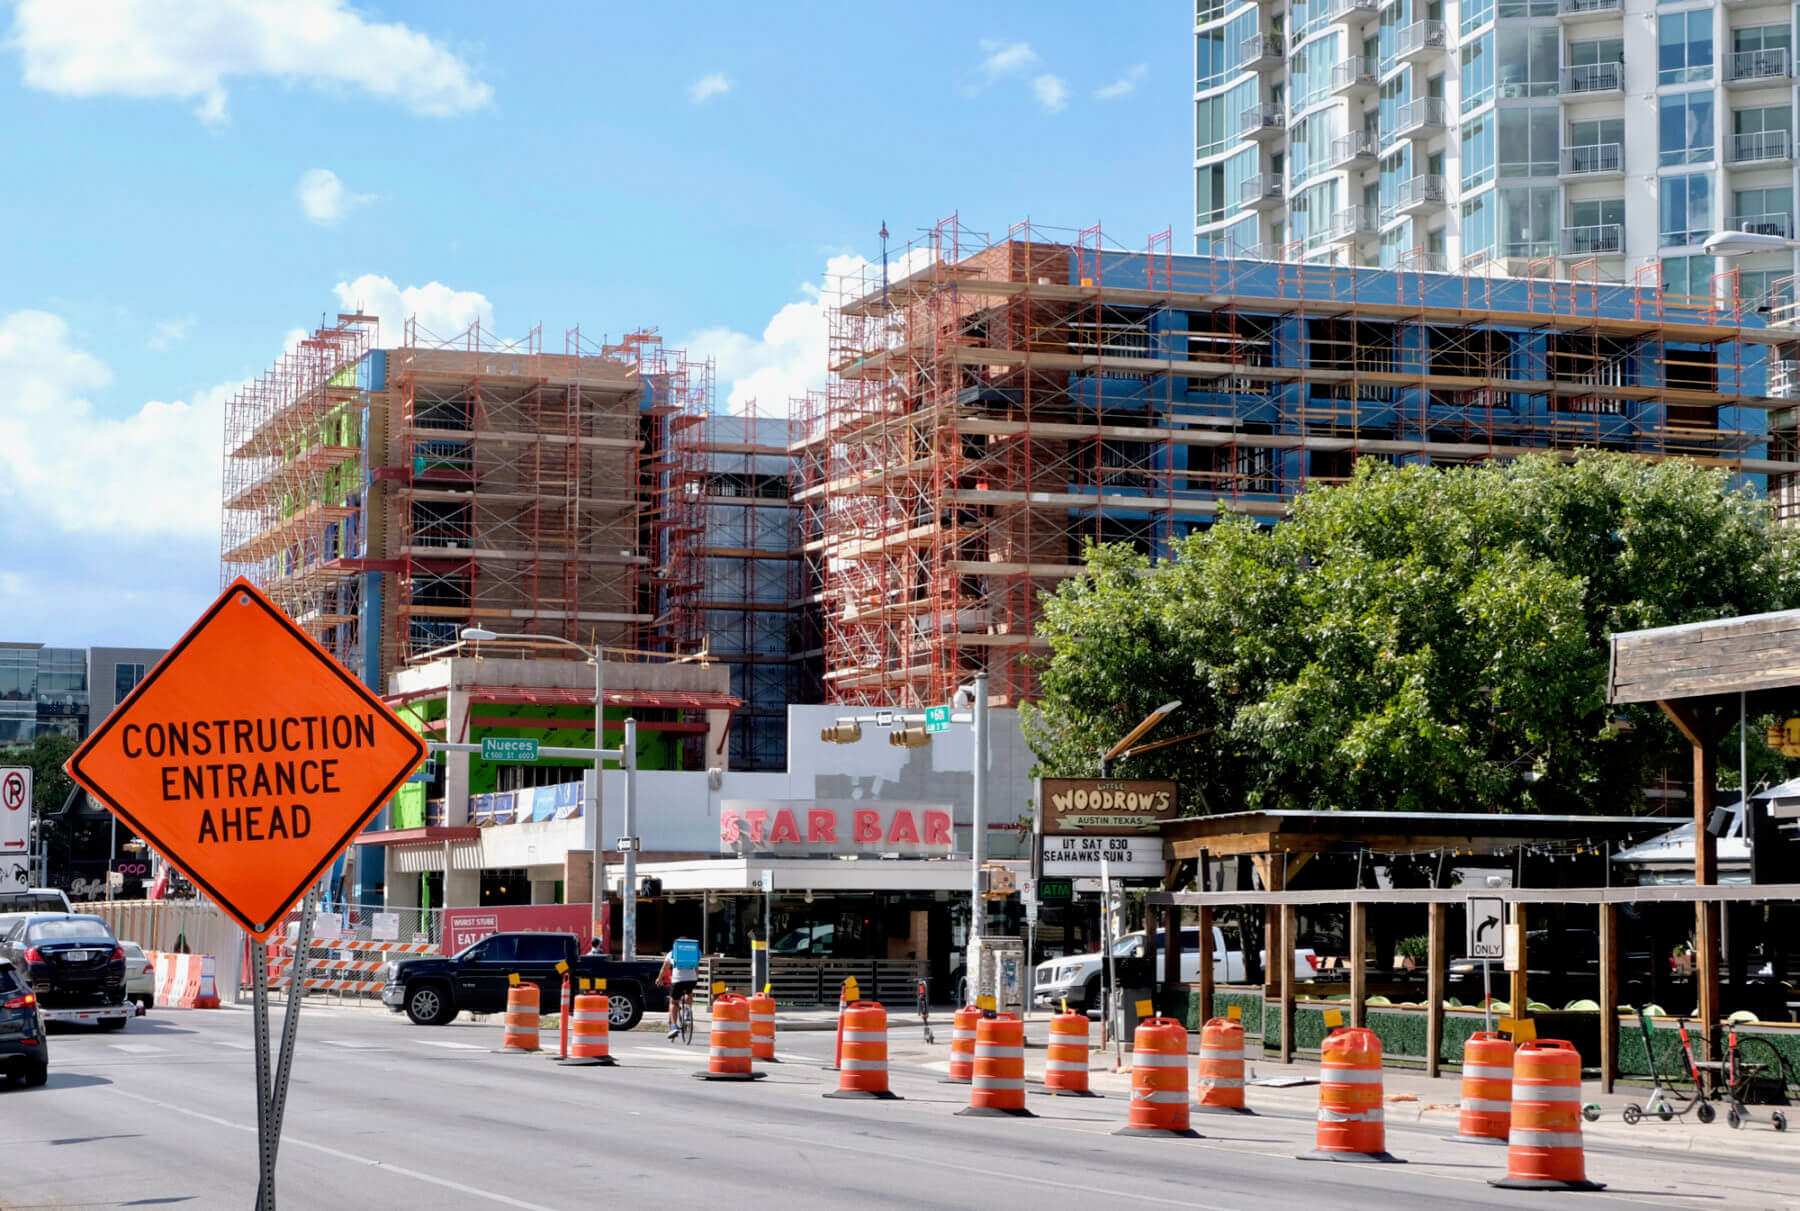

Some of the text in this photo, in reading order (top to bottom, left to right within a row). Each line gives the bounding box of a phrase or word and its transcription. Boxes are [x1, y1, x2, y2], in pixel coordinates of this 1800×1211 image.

[123, 714, 375, 758] CONSTRUCTION
[487, 739, 533, 751] Nueces
[161, 759, 341, 801] ENTRANCE
[1051, 788, 1170, 812] WOODROW'S
[198, 805, 312, 844] AHEAD
[720, 808, 952, 844] STAR BAR
[1113, 816, 1144, 825] TEXAS
[1063, 839, 1128, 849] UT SAT 630
[1044, 850, 1133, 862] SEAHAWKS SUN 3
[1041, 884, 1070, 897] ATM
[457, 933, 477, 945] EAT
[1475, 944, 1500, 955] ONLY
